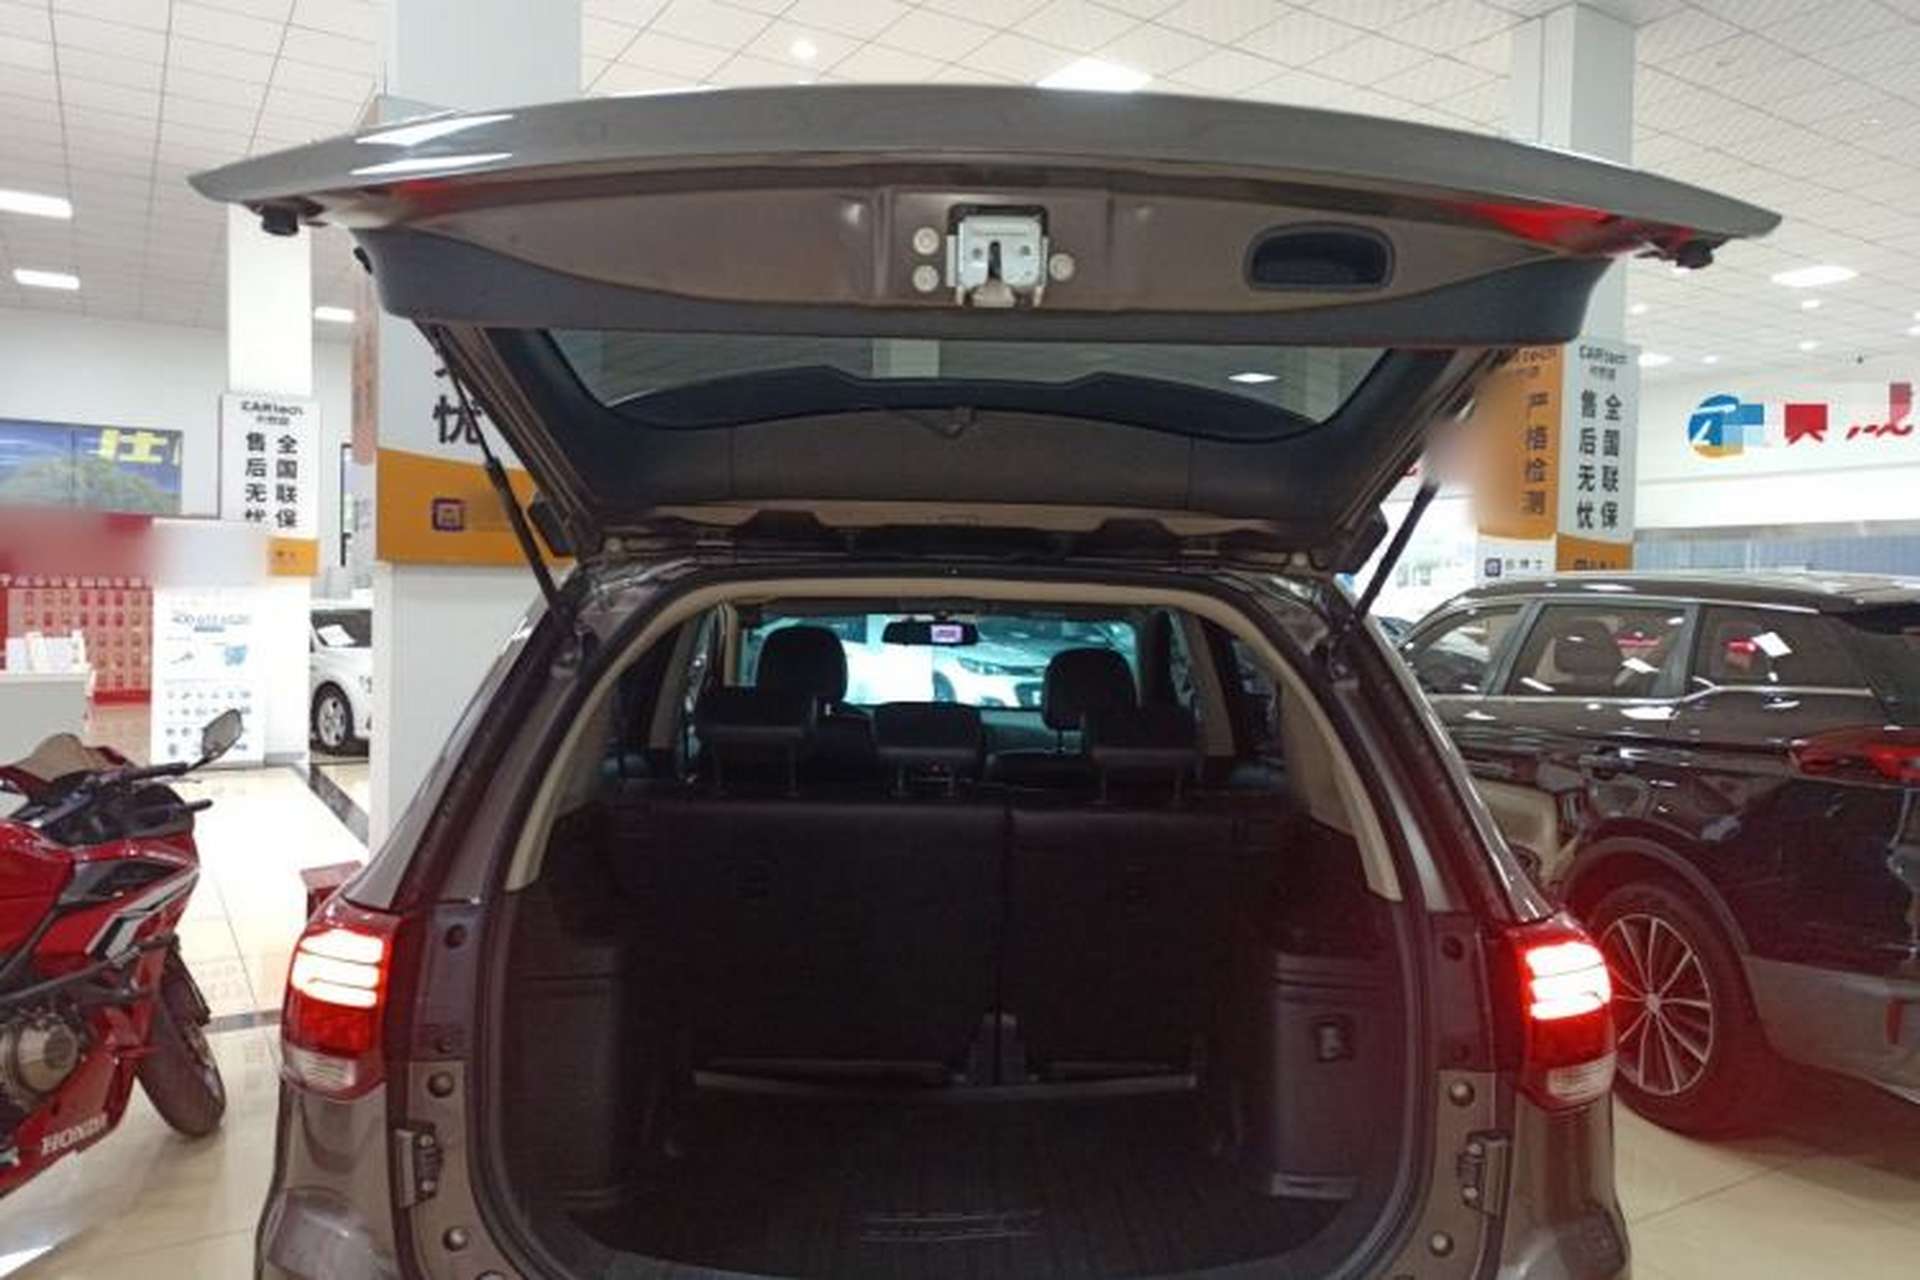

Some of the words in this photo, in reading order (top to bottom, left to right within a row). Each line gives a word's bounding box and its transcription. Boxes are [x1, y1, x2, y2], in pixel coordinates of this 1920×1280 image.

[433, 369, 483, 444] 忧
[244, 432, 267, 522] 售后无忧
[275, 434, 298, 528] 全国联保
[1577, 389, 1597, 529] 售后无忧
[1601, 393, 1621, 528] 全国联保
[42, 1113, 107, 1156] HONDA
